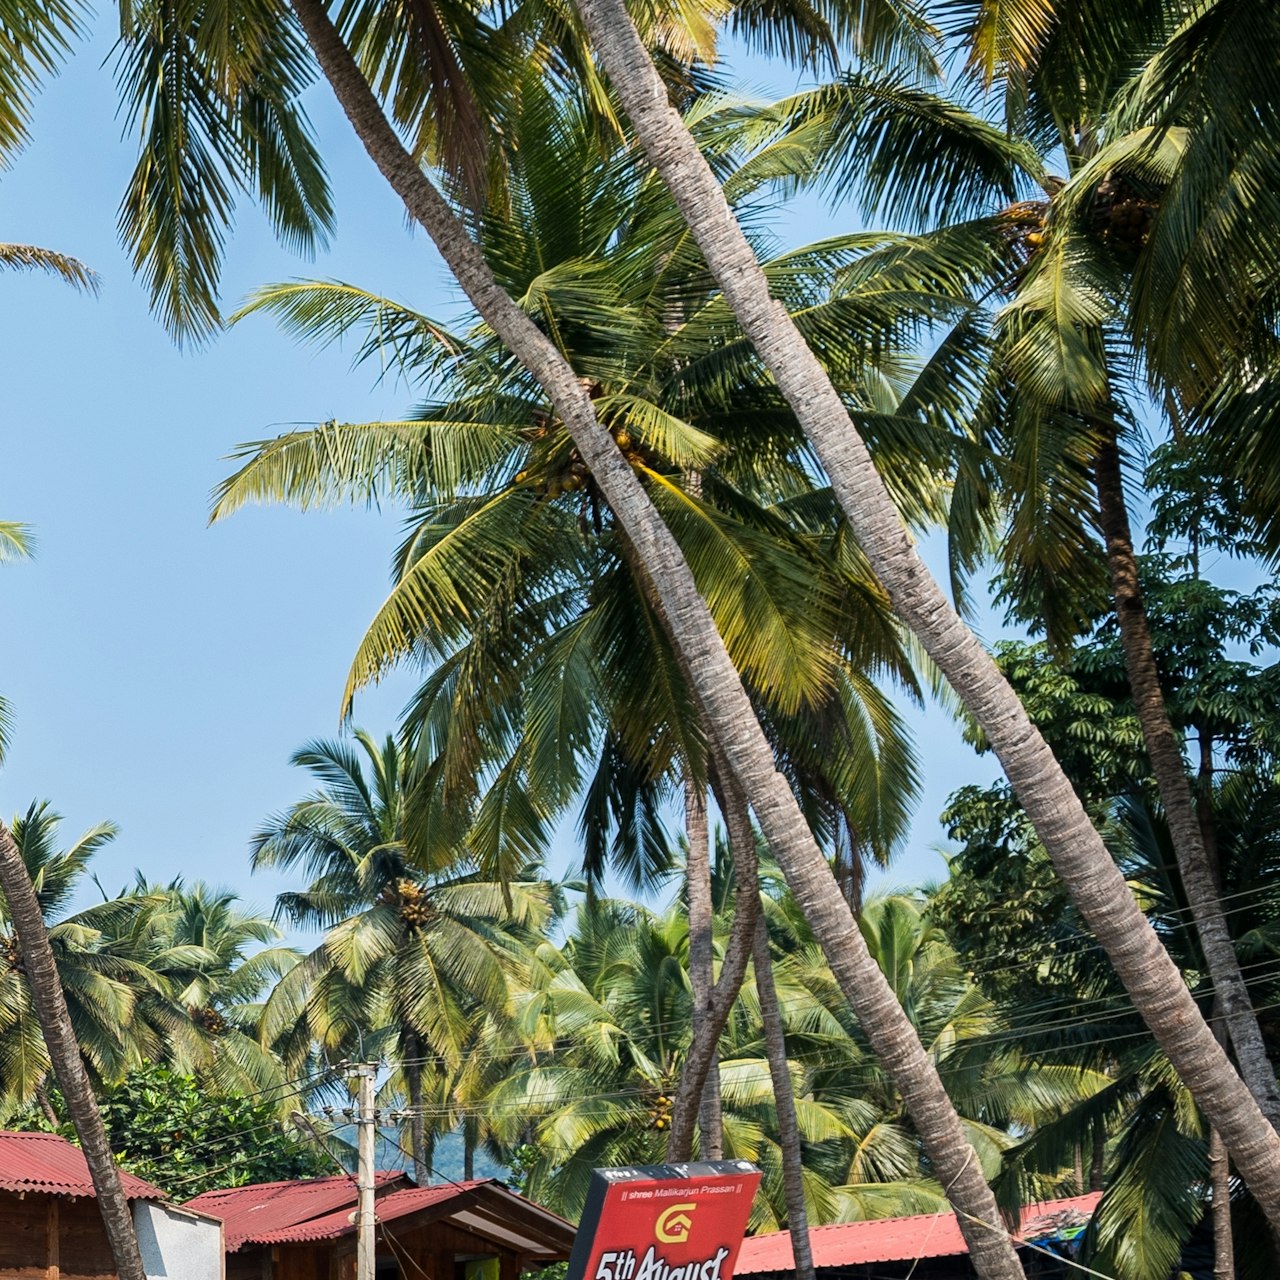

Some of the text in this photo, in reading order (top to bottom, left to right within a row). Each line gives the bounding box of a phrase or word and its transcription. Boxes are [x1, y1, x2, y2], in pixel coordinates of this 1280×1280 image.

[629, 1190, 653, 1200] shree
[654, 1188, 699, 1198] Mallikarjun
[700, 1185, 735, 1194] Prassan
